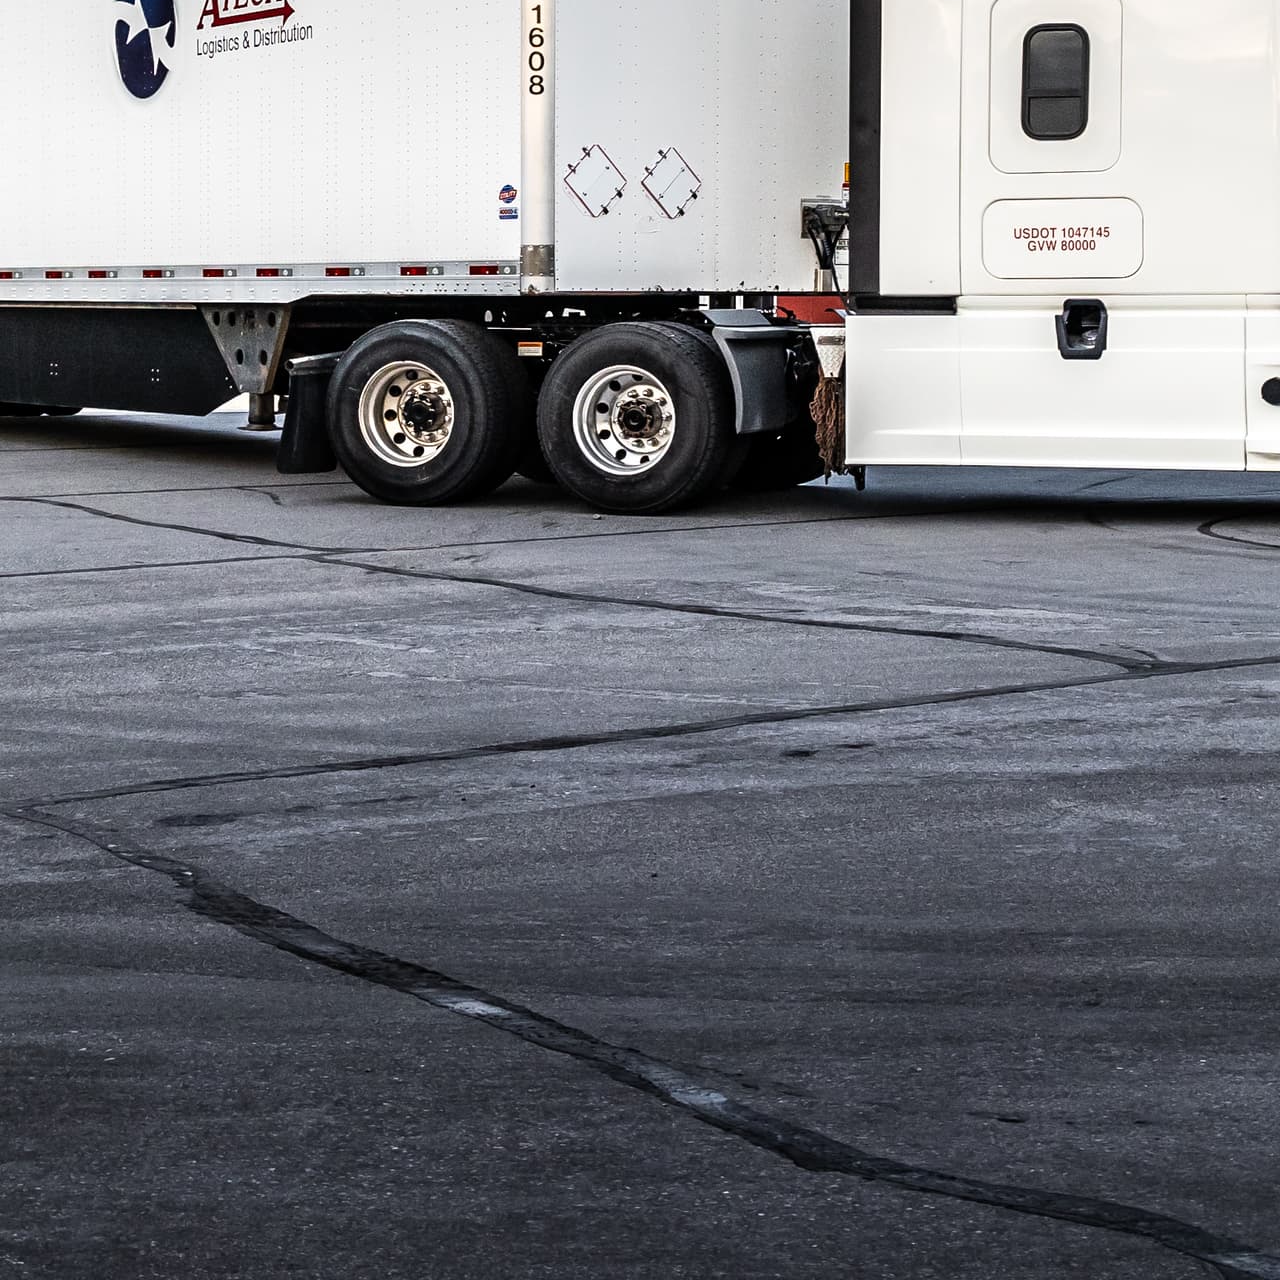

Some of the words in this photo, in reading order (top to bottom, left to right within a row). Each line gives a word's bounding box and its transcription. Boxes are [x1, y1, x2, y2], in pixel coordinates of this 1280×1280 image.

[196, 33, 239, 59] Logistics
[242, 31, 251, 49] &
[253, 23, 313, 47] Distribution
[528, 4, 545, 96] 1608
[1013, 227, 1057, 239] USDOT
[1061, 226, 1110, 238] 1047145
[1027, 239, 1057, 251] GVW
[1060, 239, 1096, 251] 80000
